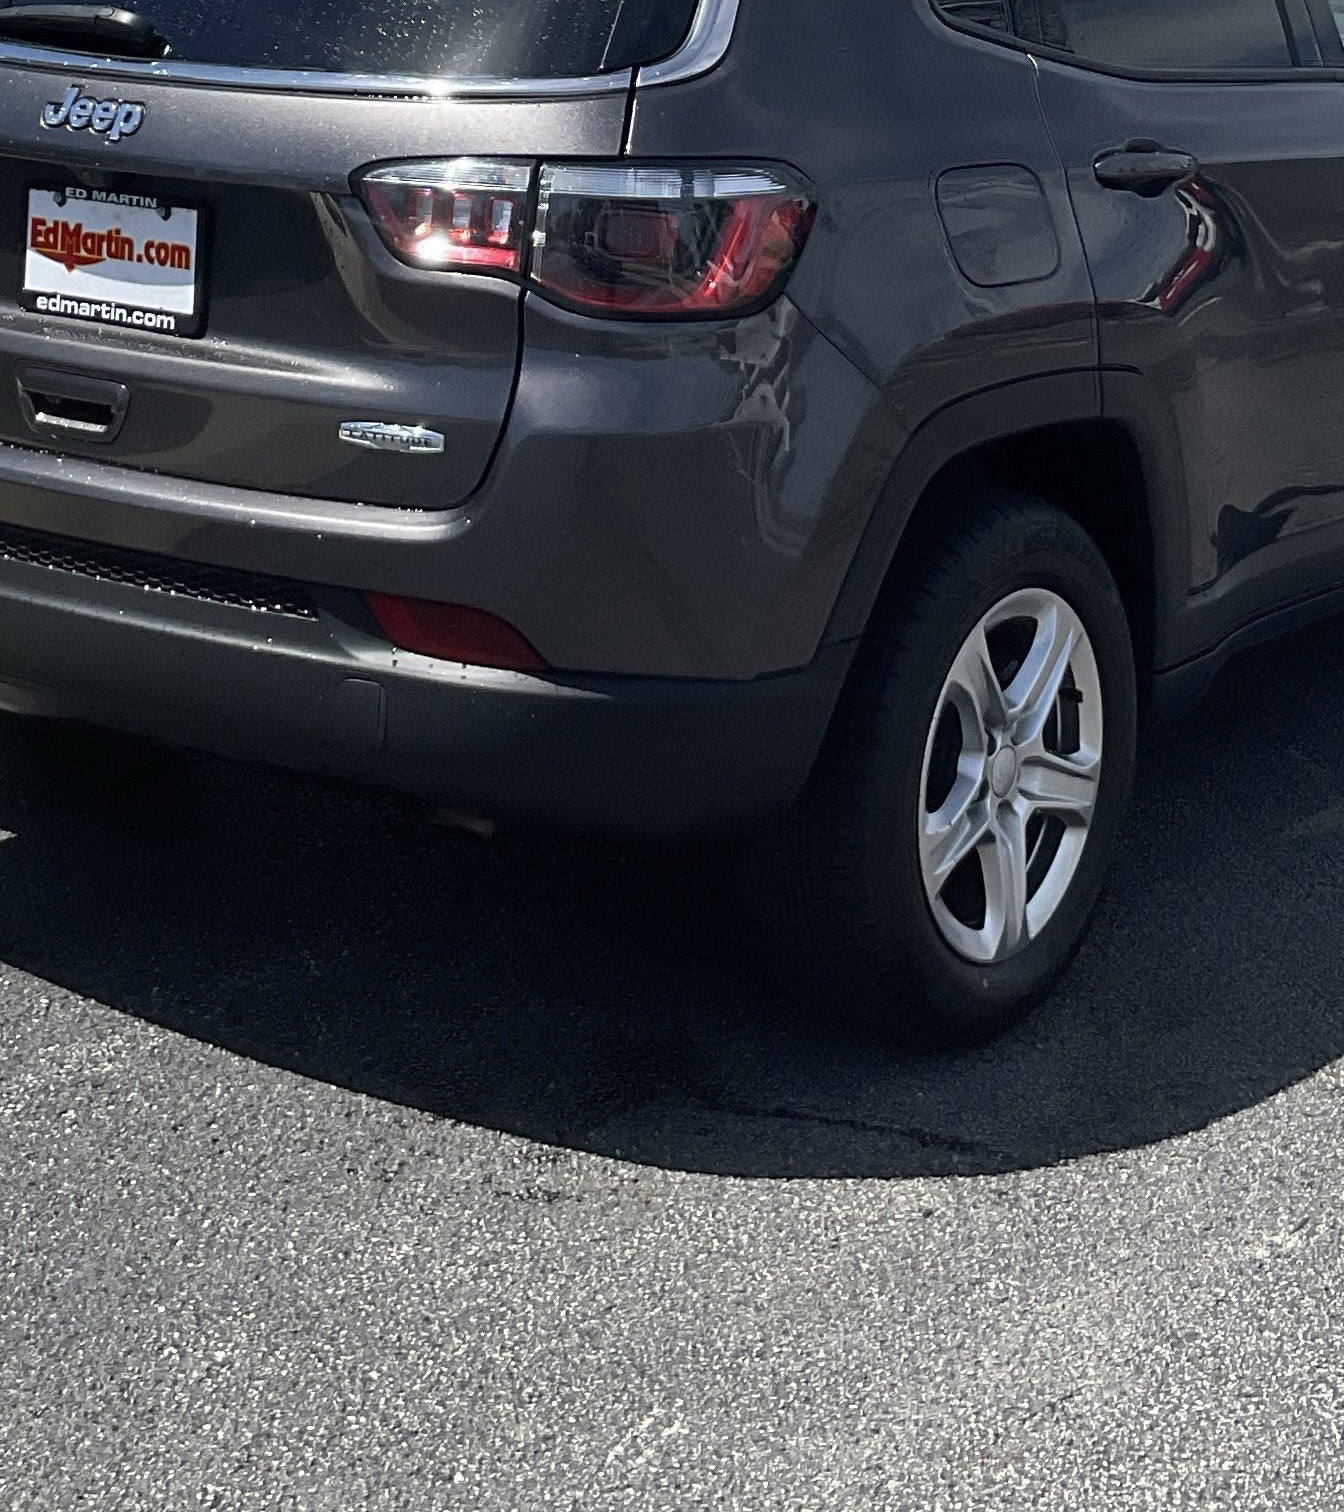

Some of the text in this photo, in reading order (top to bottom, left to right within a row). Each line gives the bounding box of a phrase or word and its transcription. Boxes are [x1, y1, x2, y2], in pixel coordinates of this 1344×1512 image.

[41, 85, 146, 143] Jeep
[65, 187, 158, 208] ED MARTIN
[30, 217, 191, 272] EdMartin.com
[36, 294, 176, 330] edmartin.com
